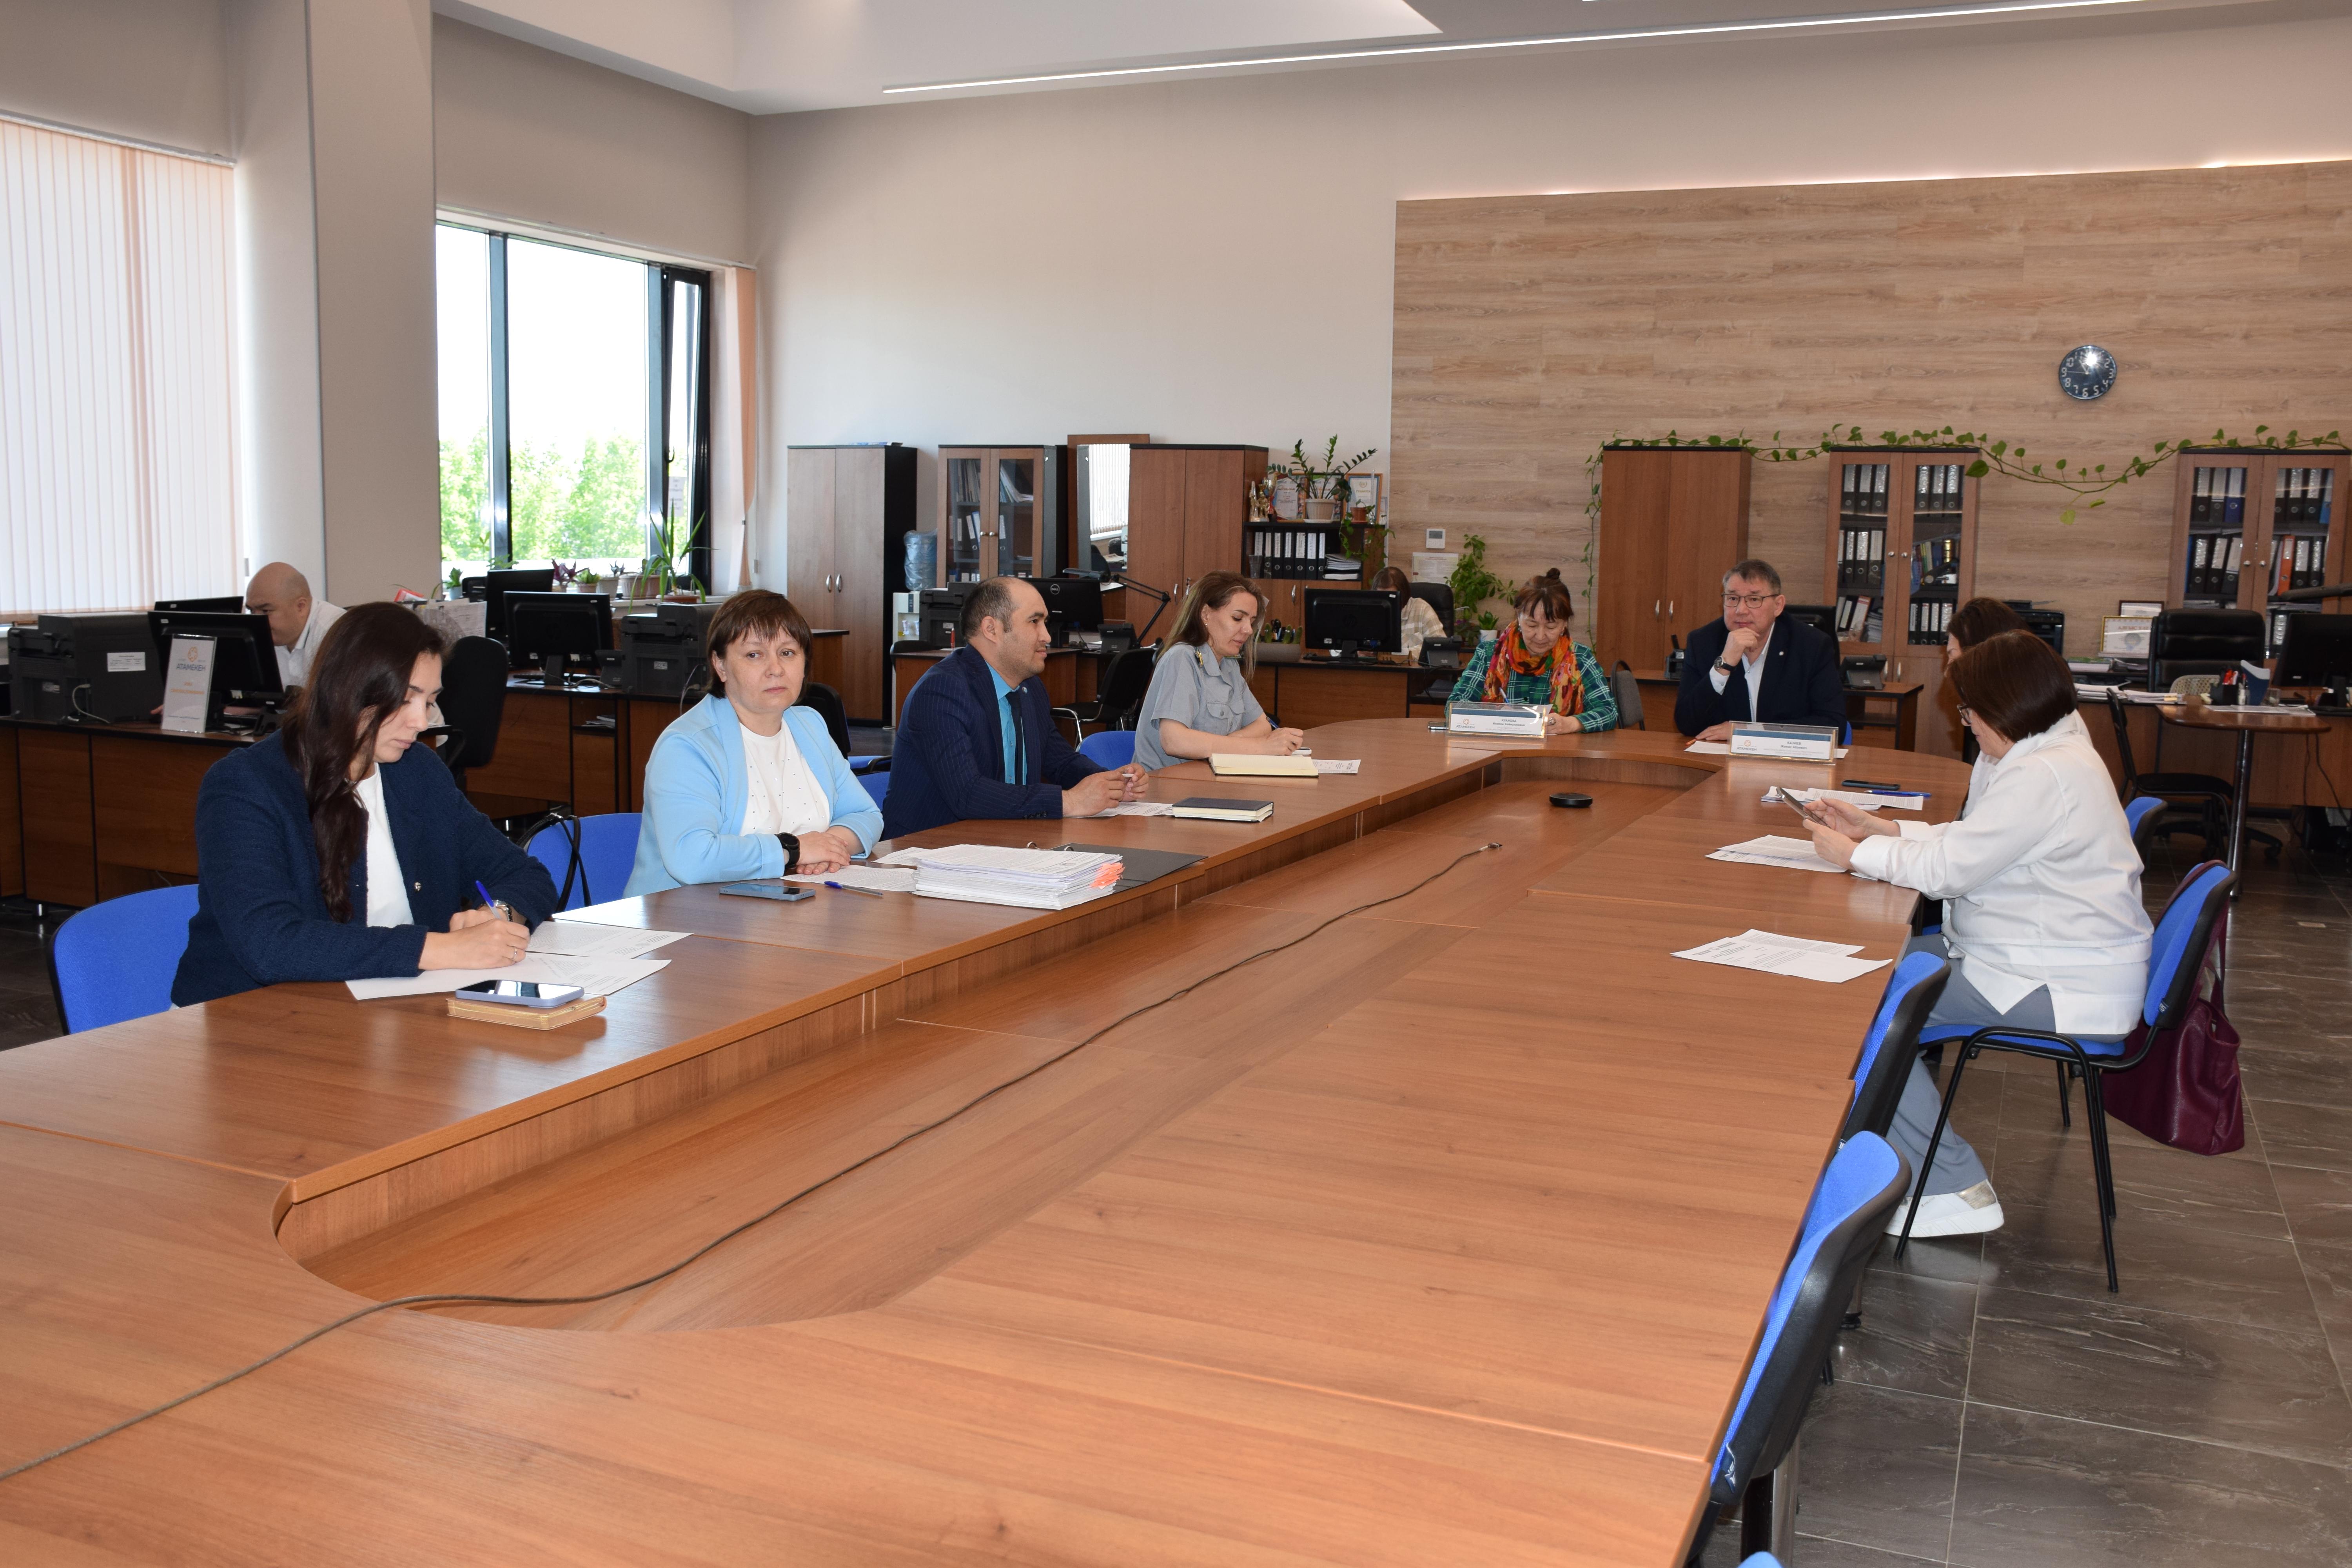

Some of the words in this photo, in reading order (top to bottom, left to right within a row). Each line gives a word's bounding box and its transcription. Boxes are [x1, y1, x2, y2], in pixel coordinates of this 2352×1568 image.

[2104, 358, 2110, 368] 2
[2062, 367, 2067, 377] 9
[2109, 368, 2114, 378] 3
[2065, 377, 2071, 387] 8
[2073, 385, 2078, 394] 7
[2082, 388, 2088, 397] 6
[2093, 385, 2099, 395] 5
